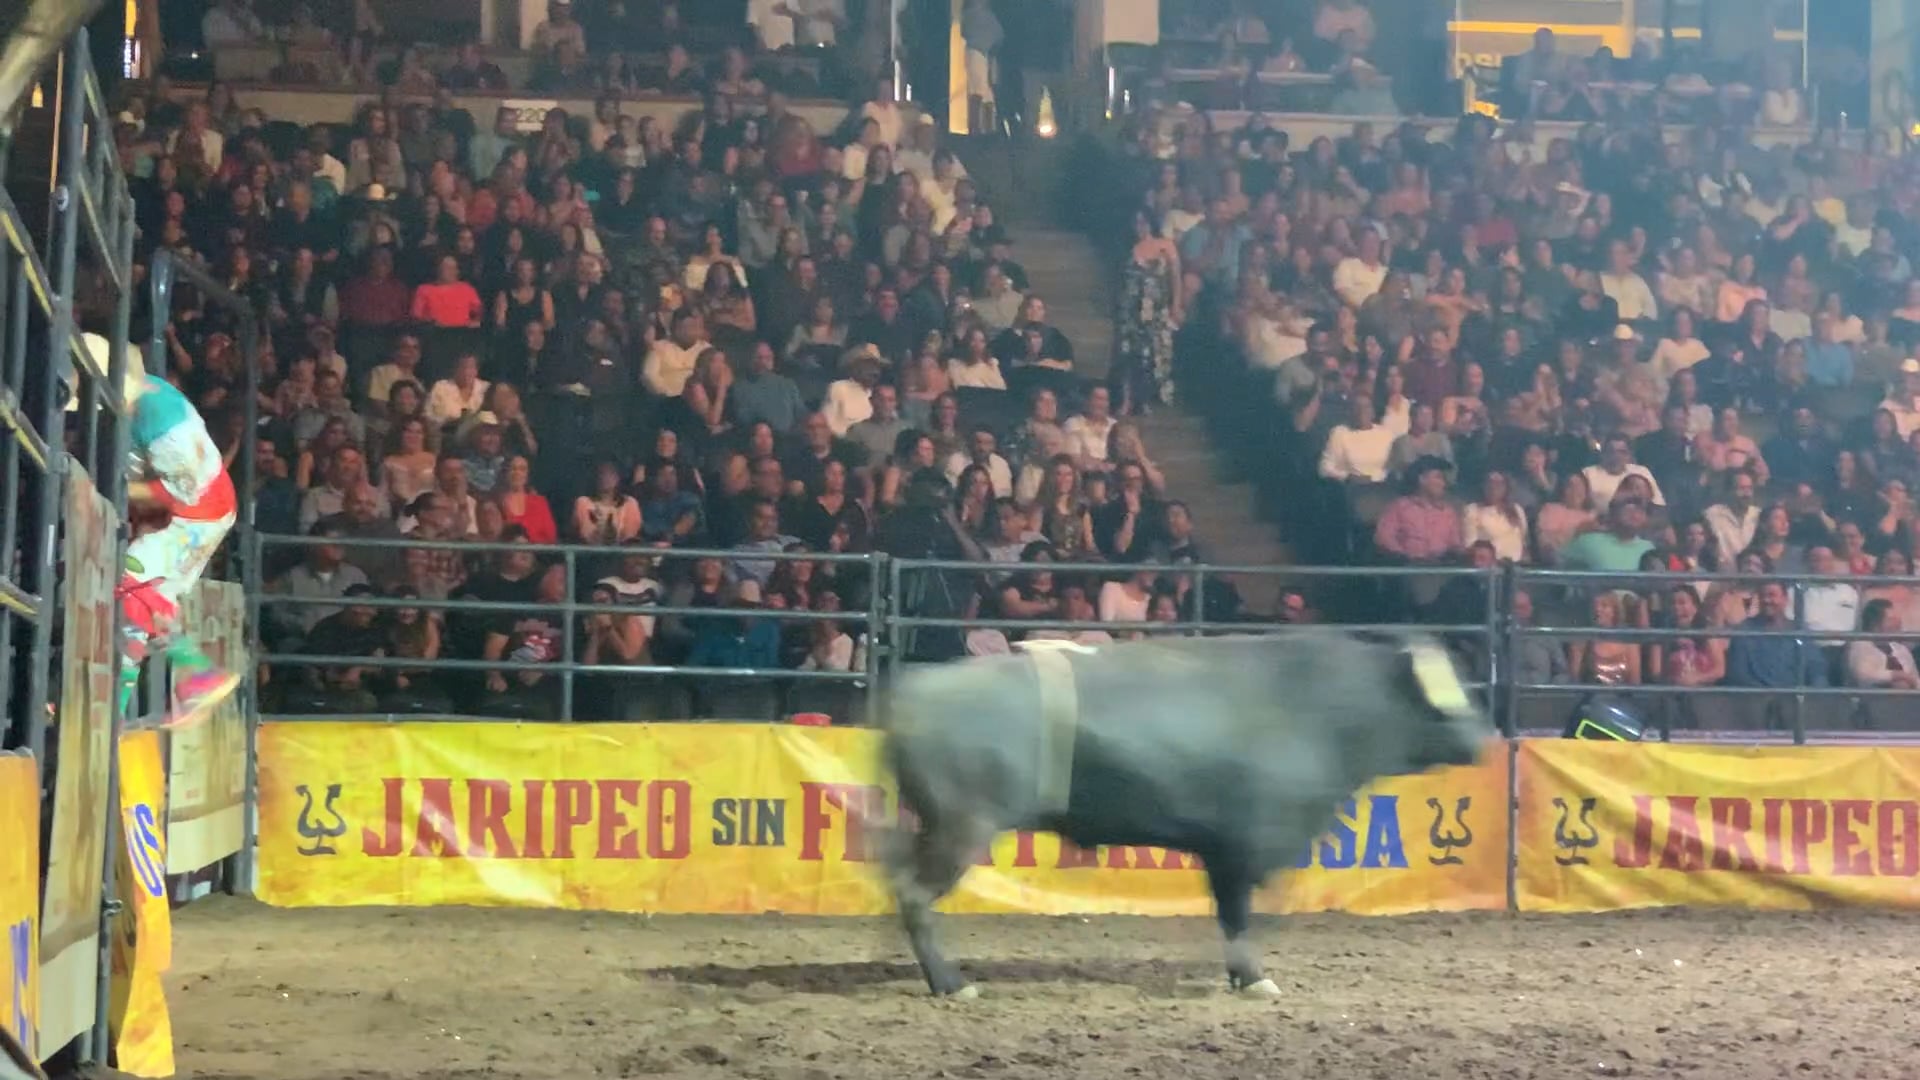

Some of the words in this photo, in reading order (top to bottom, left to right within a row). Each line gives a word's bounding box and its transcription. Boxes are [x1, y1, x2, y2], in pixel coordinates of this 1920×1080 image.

[362, 777, 692, 860] JARIPEO
[713, 798, 785, 847] SIN
[1298, 794, 1409, 869] SA
[1613, 796, 1919, 877] JARIPEO
